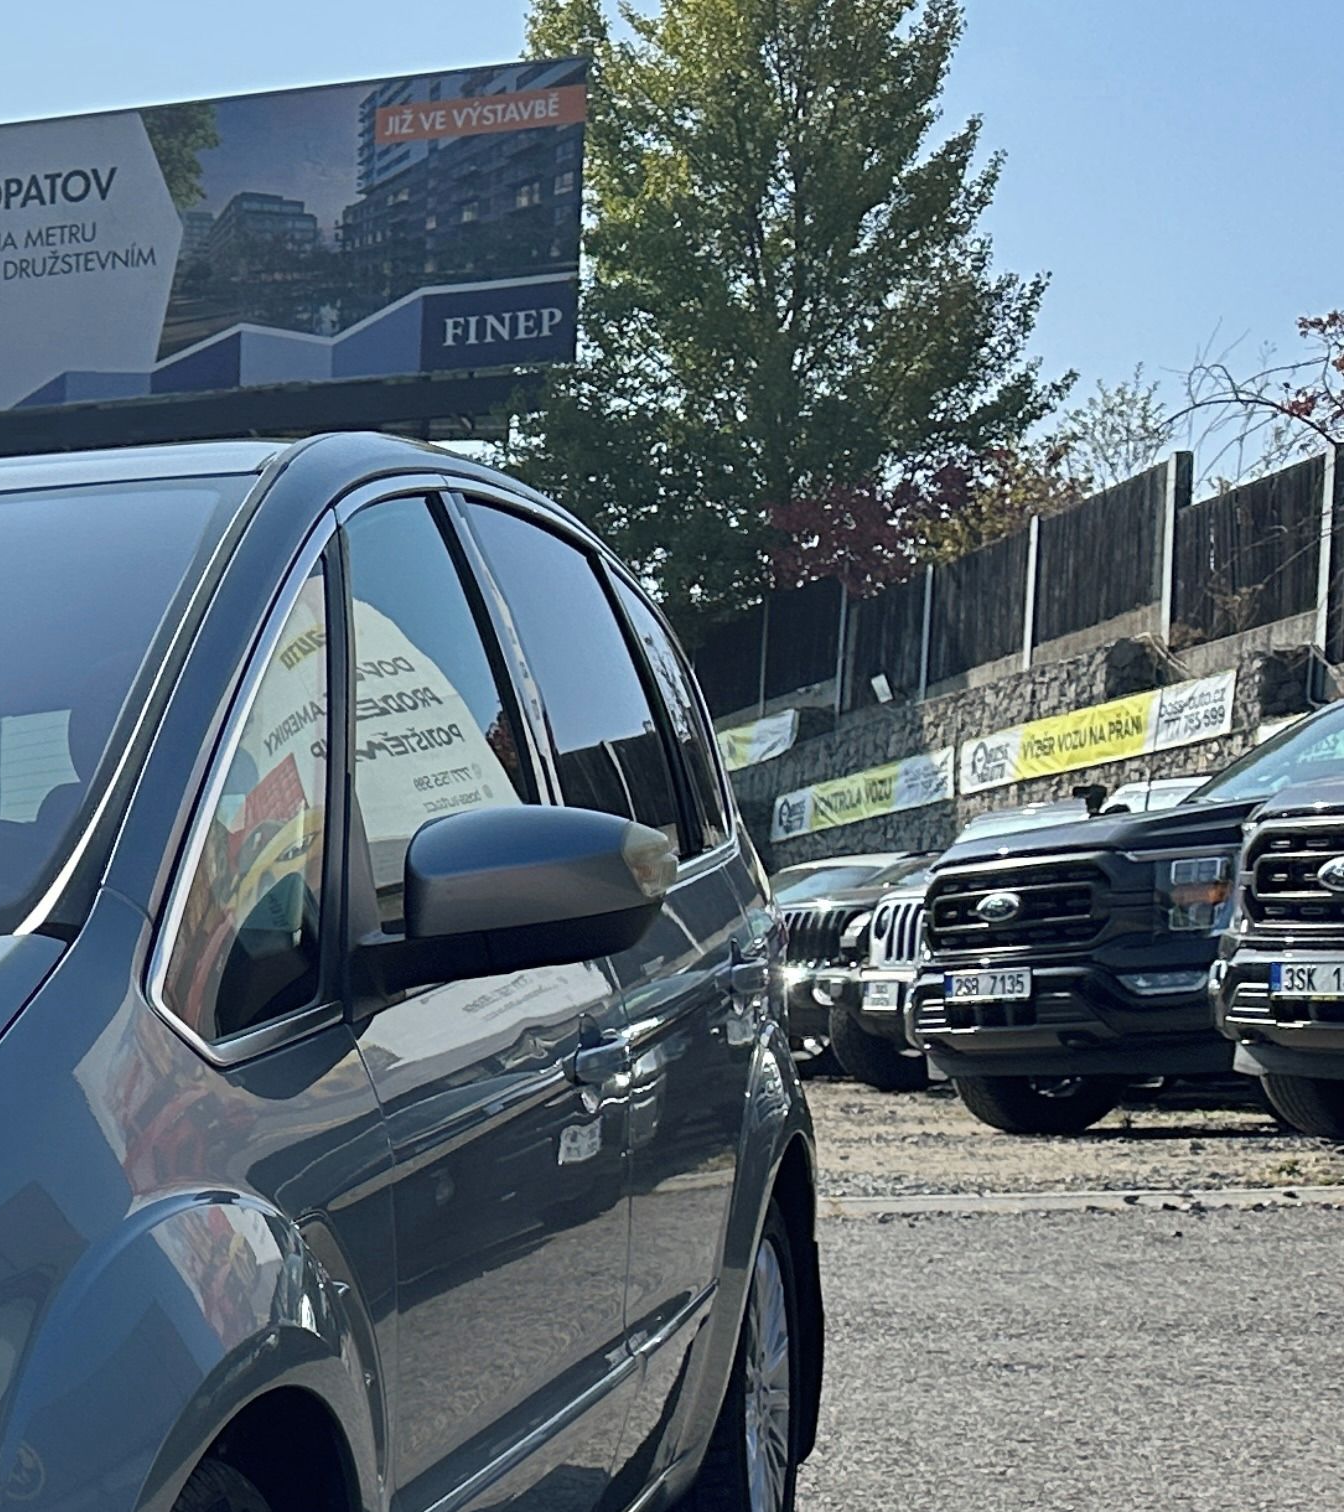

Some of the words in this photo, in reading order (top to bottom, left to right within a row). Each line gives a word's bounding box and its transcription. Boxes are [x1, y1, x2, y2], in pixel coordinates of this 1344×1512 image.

[384, 109, 414, 136] JIŽ
[420, 109, 446, 131] VE
[453, 93, 560, 128] VÝSTAVBĚ
[24, 222, 97, 250] METRU
[3, 243, 158, 282] DRUŽSTEVNÍM
[442, 307, 563, 347] FINEP
[1058, 728, 1087, 753] VOZU
[1089, 725, 1105, 745] NA
[990, 974, 1025, 995] 7135
[1284, 968, 1317, 991] 3SK
[1333, 968, 1344, 991] 1
